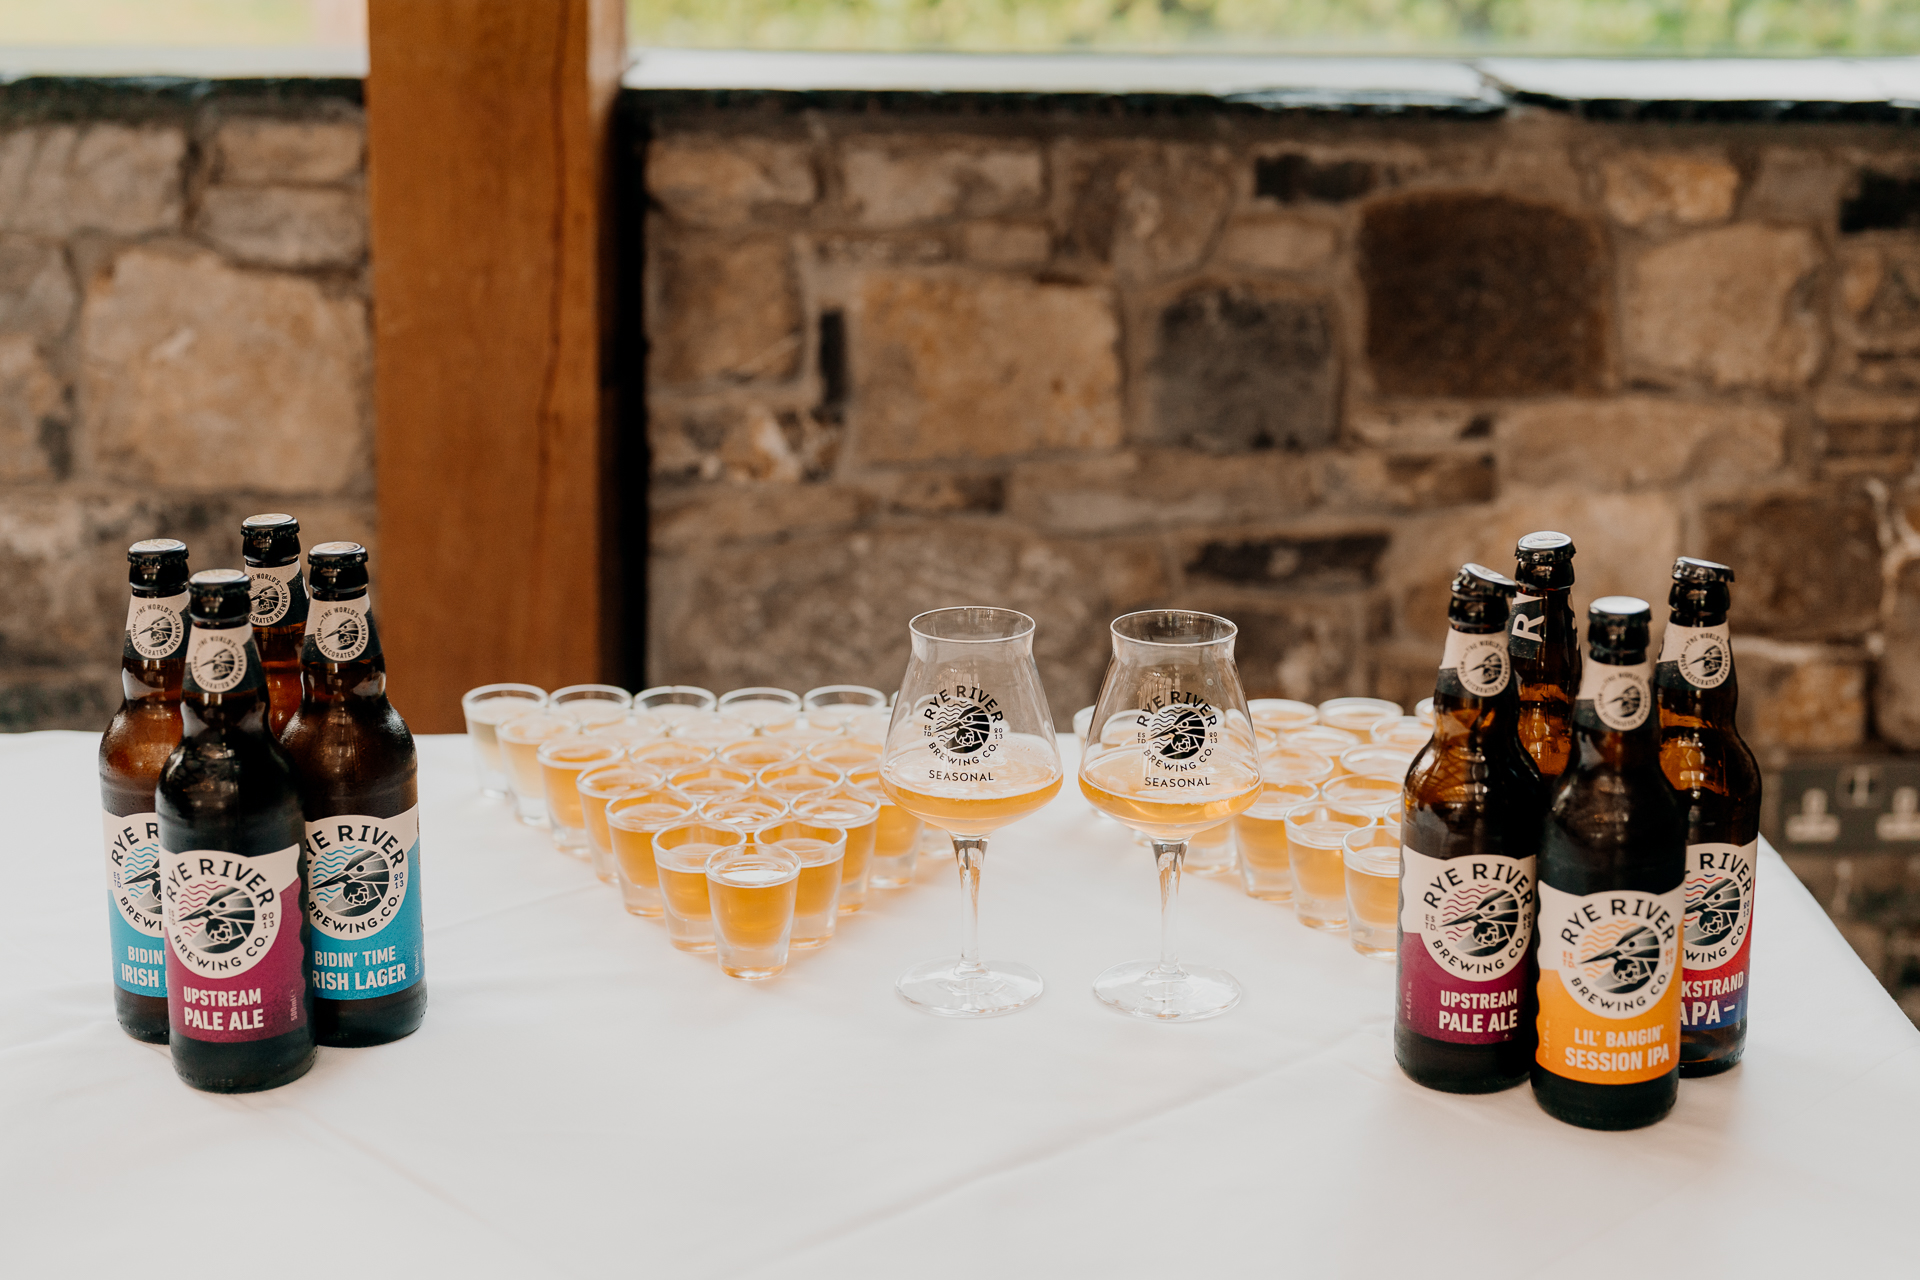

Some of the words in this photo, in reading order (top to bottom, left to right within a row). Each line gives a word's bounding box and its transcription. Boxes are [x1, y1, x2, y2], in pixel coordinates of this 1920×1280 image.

[249, 613, 274, 624] CORATED
[321, 609, 333, 620] THE
[316, 627, 324, 645] MOST
[321, 644, 356, 659] DECORATED
[924, 689, 951, 720] RYE
[956, 685, 1004, 724] RIVER
[1136, 695, 1165, 728] RYE
[1170, 691, 1218, 728] RIVER
[928, 742, 980, 766] BREWING
[1143, 749, 1197, 772] BREWING
[928, 769, 994, 782] SEASONAL
[1144, 776, 1211, 788] SEASONAL
[111, 826, 140, 867] RYE
[337, 824, 405, 869] RIVER
[166, 861, 193, 903] RYE
[199, 858, 275, 908] RIVER
[1423, 867, 1464, 909] RYE
[1472, 863, 1533, 909] RIVER
[1699, 852, 1752, 896] RIVER
[120, 896, 162, 931] BREWI
[263, 920, 275, 929] 13
[308, 901, 378, 934] BREWING
[1425, 914, 1436, 922] ES
[1560, 903, 1602, 945] RYE
[1611, 898, 1675, 943] RIVER
[174, 934, 242, 971] BREWING
[314, 950, 358, 968] BIDIN'
[362, 945, 397, 966] TIME
[1432, 939, 1505, 974] BREWING
[1685, 947, 1727, 963] WING
[121, 963, 159, 988] IRISH
[312, 970, 349, 991] RISH
[355, 962, 407, 990] LAGER
[183, 985, 262, 1008] UPSTREAM
[1440, 988, 1518, 1009] UPSTREAM
[1571, 977, 1646, 1011] BREWING
[184, 1006, 224, 1031] PALE
[228, 1008, 265, 1031] ALE
[1438, 1010, 1484, 1033] PALE
[1487, 1009, 1518, 1032] ALE
[1574, 1027, 1601, 1047] LIL'
[1605, 1024, 1664, 1048] BANGIN'
[1564, 1046, 1643, 1072] SESSION
[1647, 1043, 1670, 1068] IPA
